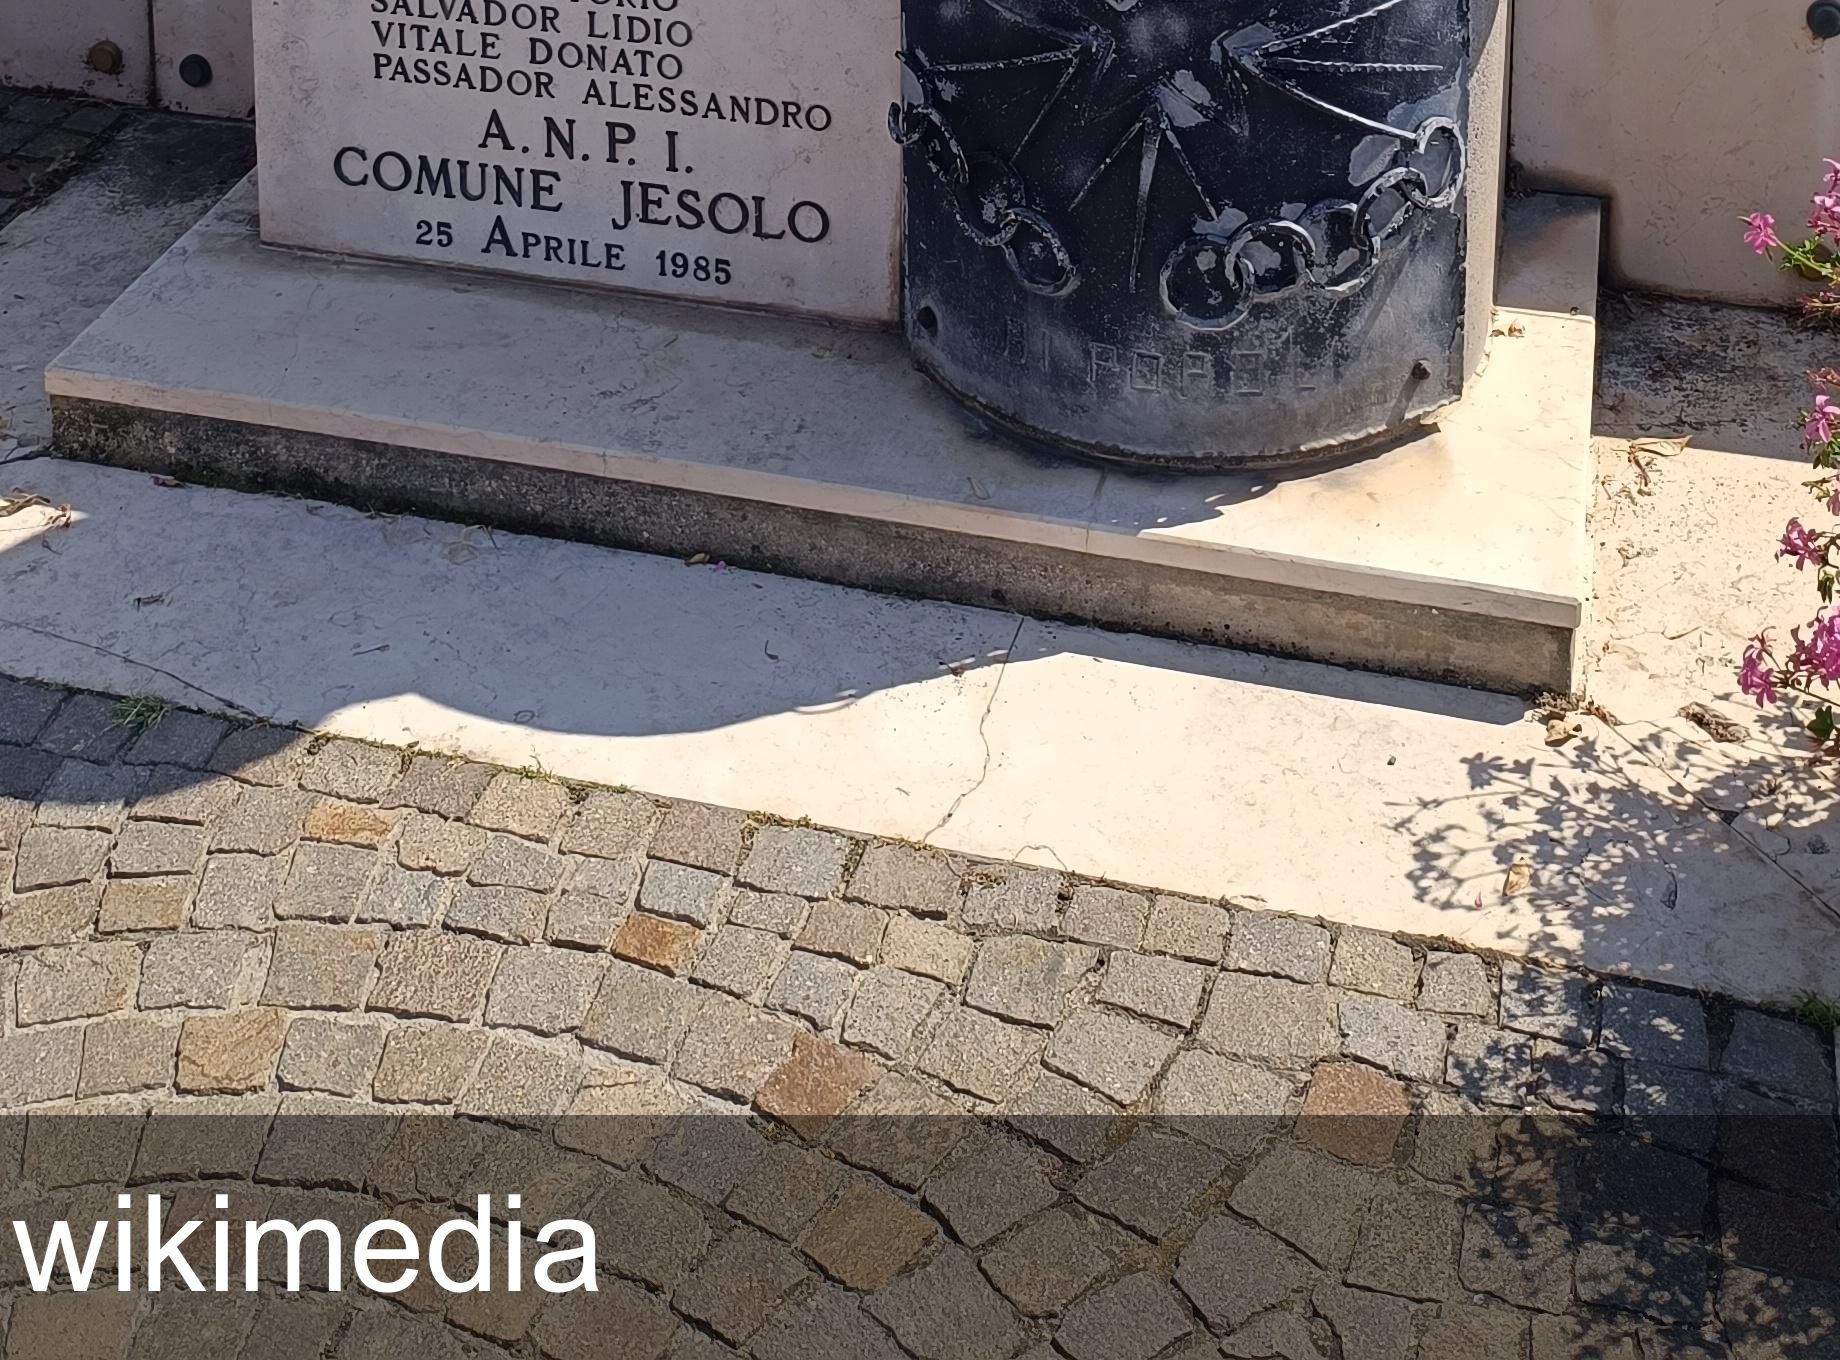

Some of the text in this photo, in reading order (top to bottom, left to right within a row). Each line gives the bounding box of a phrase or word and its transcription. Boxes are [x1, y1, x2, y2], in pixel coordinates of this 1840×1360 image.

[371, 20, 683, 80] VITALE DONATO
[587, 11, 693, 47] LIDIO
[373, 53, 832, 131] PASSADOR ALESSANDRO
[334, 146, 830, 243] COMUNE JESOLO
[416, 220, 453, 247] 25
[656, 250, 731, 285] 1985
